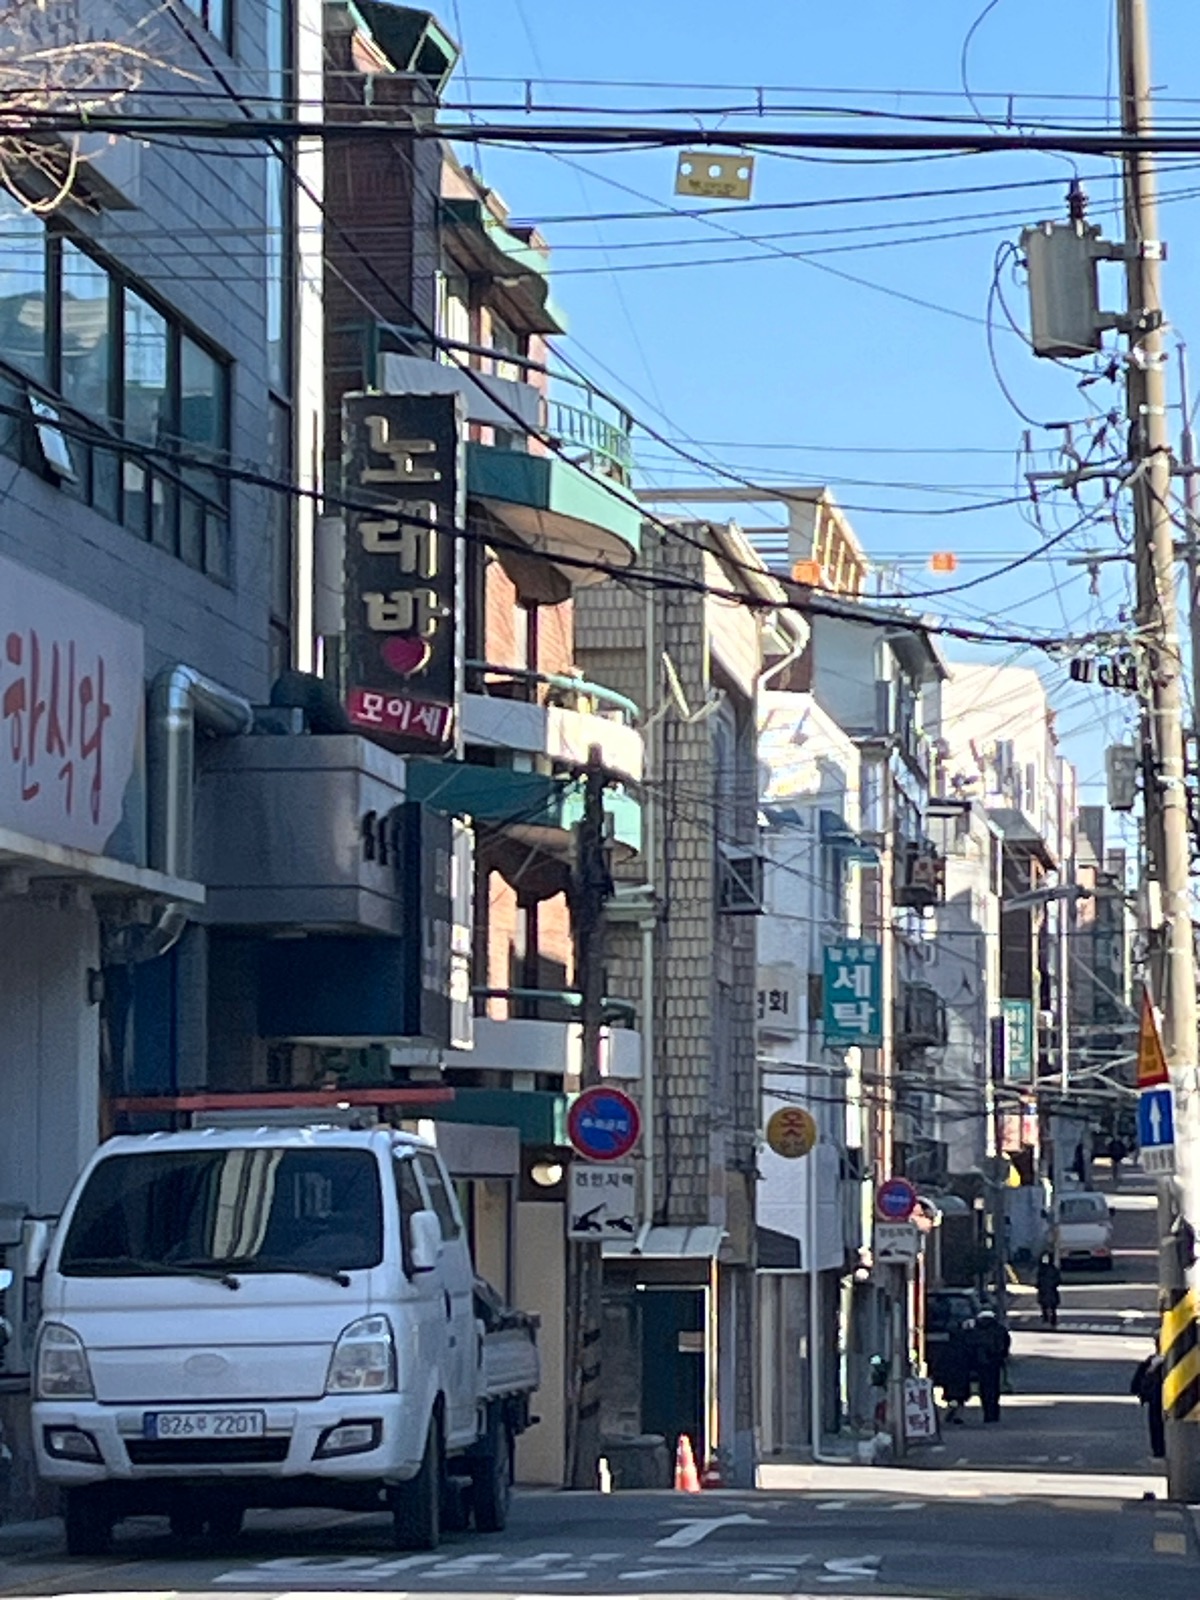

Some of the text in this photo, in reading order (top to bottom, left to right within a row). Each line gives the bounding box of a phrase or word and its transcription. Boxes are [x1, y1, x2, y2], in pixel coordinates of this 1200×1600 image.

[359, 414, 450, 673] 노래방
[3, 627, 112, 826] 한식당
[356, 691, 444, 737] 모이세
[832, 964, 876, 1034] 세탁
[575, 1171, 634, 1188] 견인지역
[213, 1415, 258, 1435] 2201
